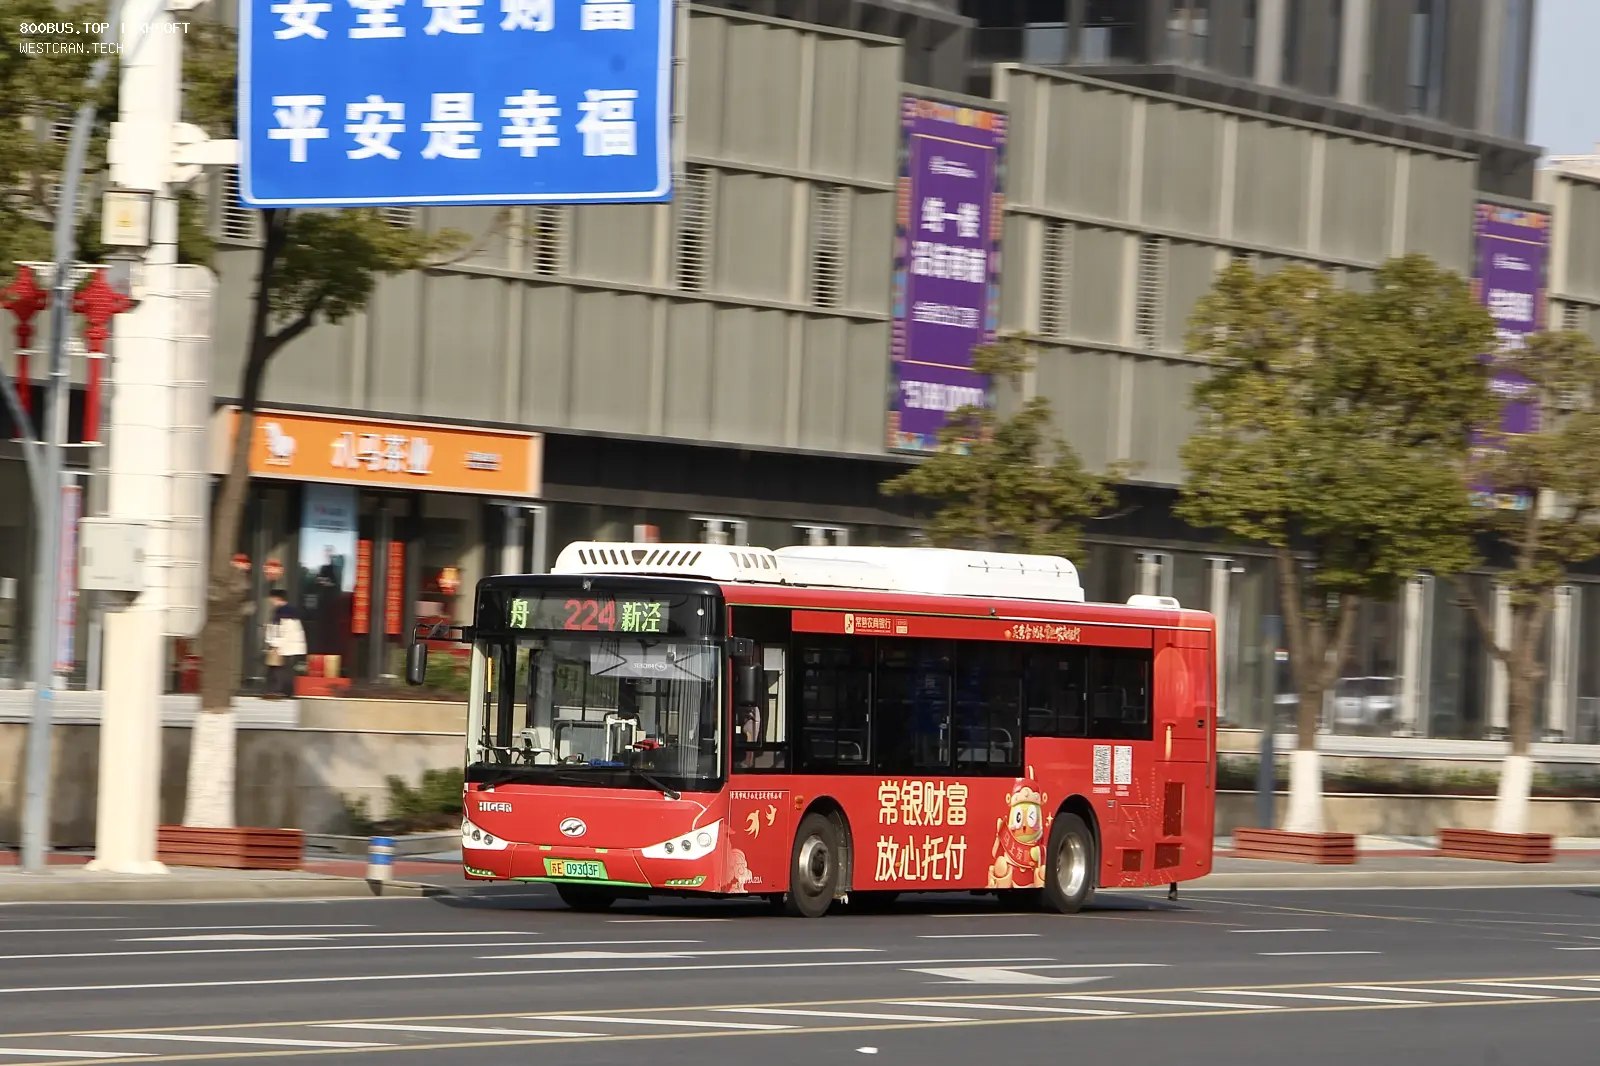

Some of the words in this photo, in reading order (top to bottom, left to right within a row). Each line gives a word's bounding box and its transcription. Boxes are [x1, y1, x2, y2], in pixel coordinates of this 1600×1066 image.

[268, 89, 639, 162] 平安是幸福
[510, 599, 530, 629] 舟
[563, 600, 616, 631] 224
[621, 602, 662, 632] 新泾
[477, 801, 512, 813] HIGER
[877, 779, 969, 827] 常银财富
[874, 834, 968, 882] 放心托付
